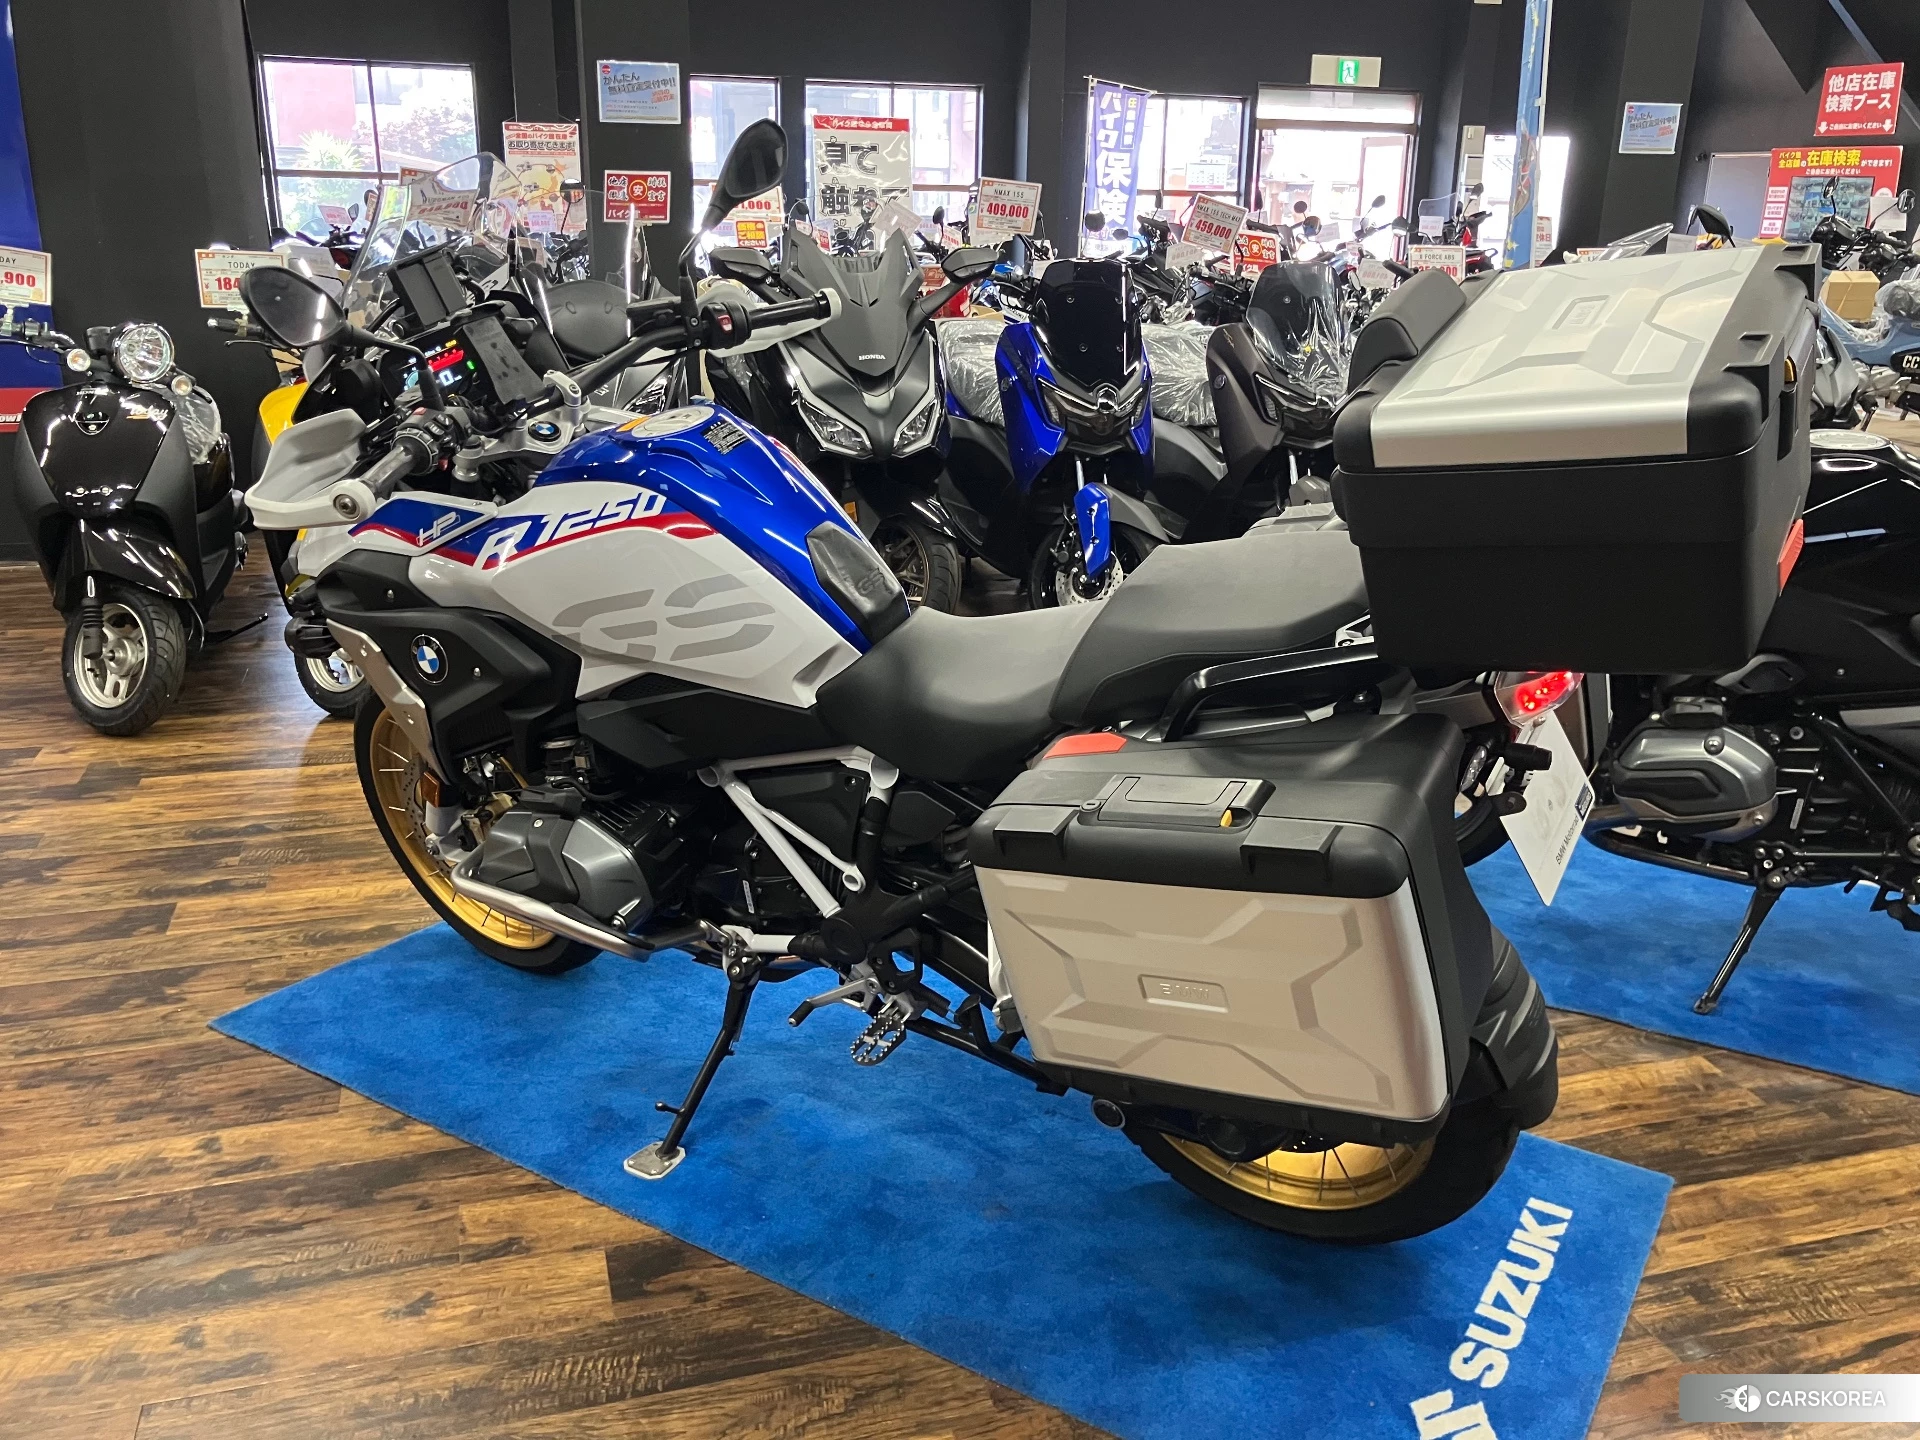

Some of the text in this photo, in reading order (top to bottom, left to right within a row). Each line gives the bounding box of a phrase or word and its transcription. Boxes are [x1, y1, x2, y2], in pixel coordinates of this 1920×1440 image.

[603, 72, 640, 85] かんたん
[1828, 71, 1897, 93] 他店在庫
[1825, 93, 1892, 113] 検索ブース
[1096, 91, 1132, 226] バイク保険
[1807, 150, 1861, 167] 在庫検索
[633, 185, 643, 196] 安
[1013, 191, 1025, 199] 155
[987, 202, 1029, 219] 409,000
[1195, 219, 1232, 240] 459,000
[416, 511, 461, 547] HP
[472, 491, 668, 570] R 1250
[552, 573, 776, 670] GS
[1449, 1197, 1573, 1389] SUZUKI
